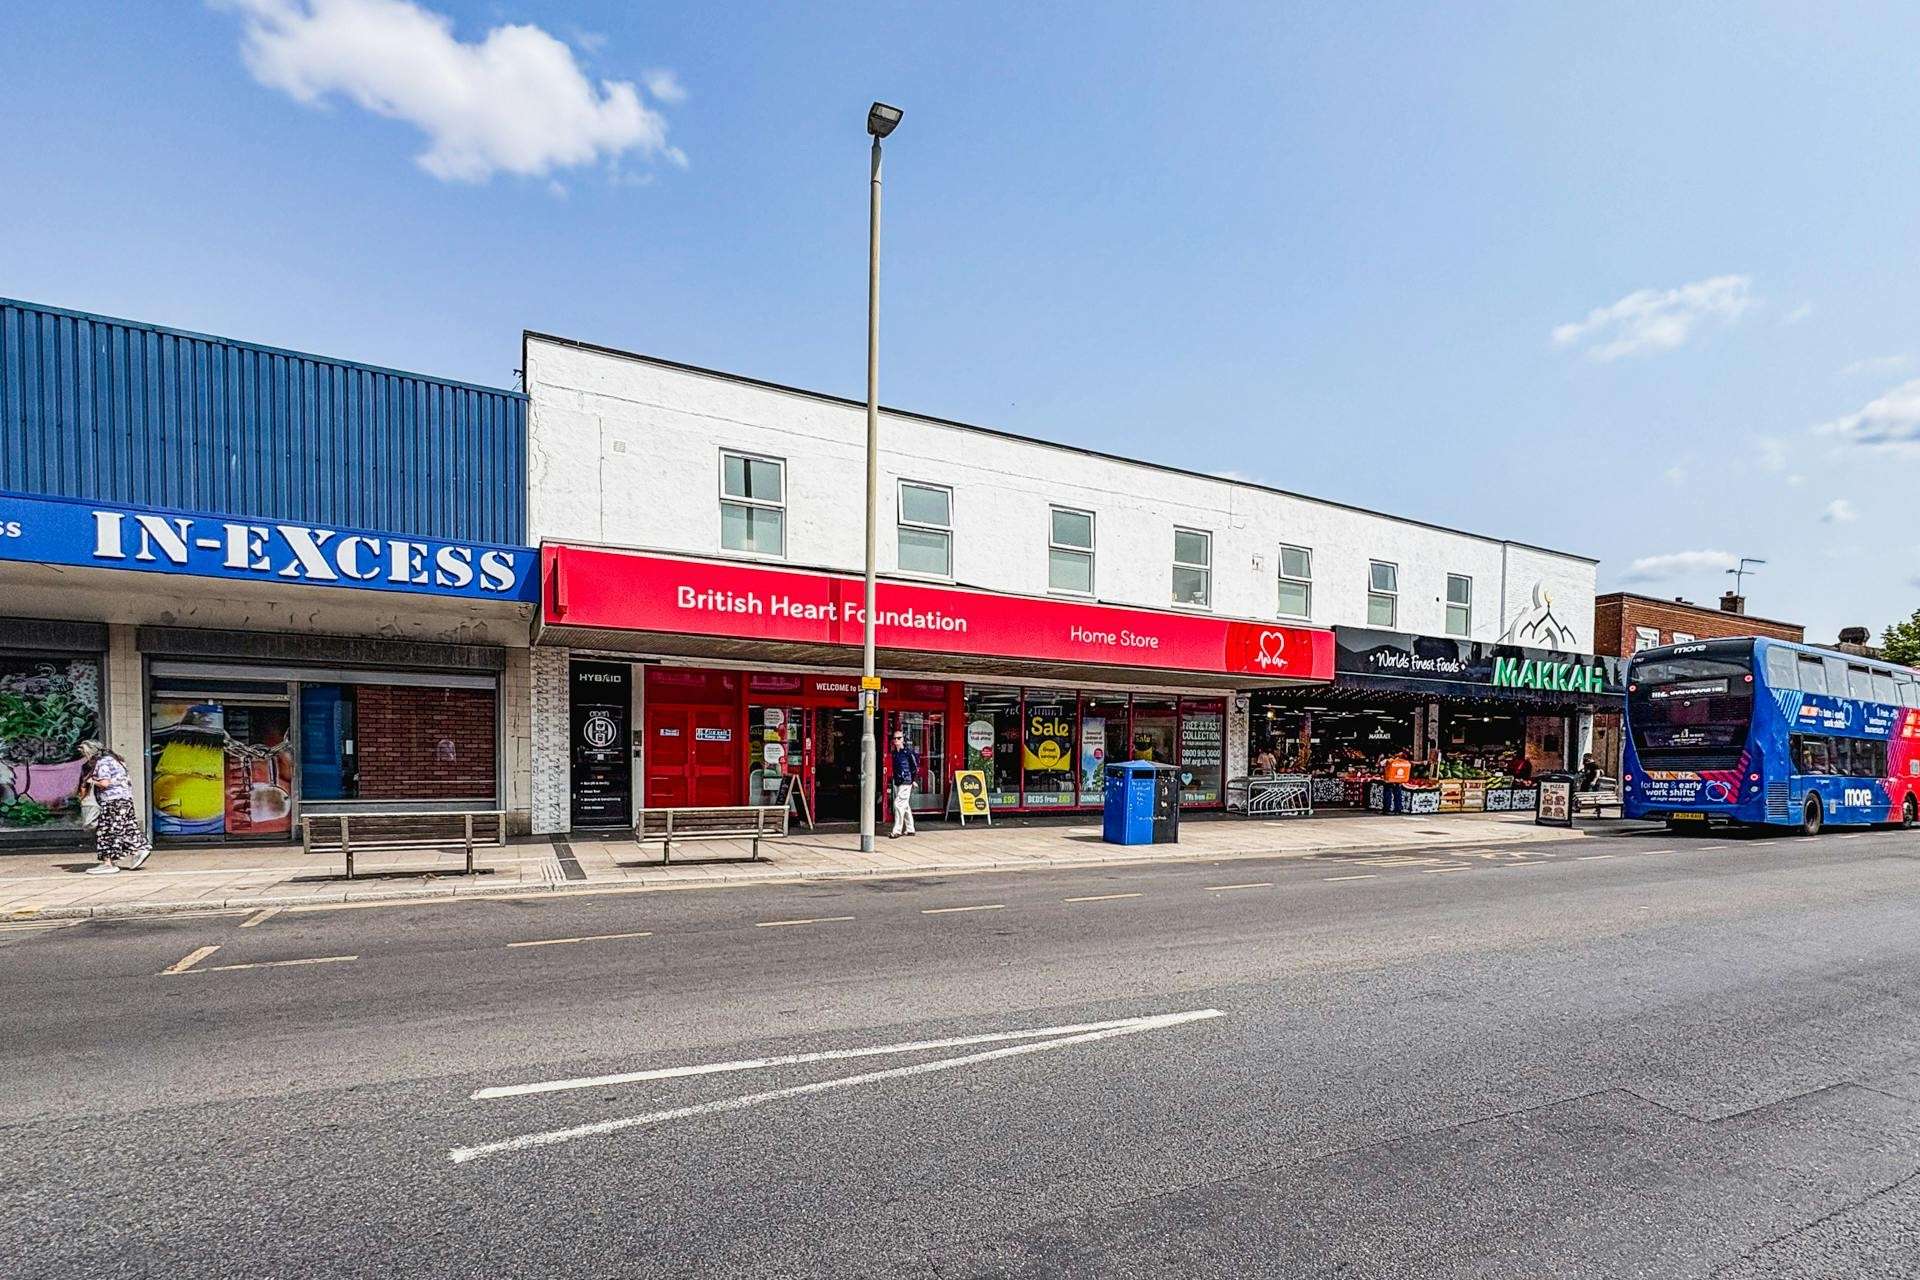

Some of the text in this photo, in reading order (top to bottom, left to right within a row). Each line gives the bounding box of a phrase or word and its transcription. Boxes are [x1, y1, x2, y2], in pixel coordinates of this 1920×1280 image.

[0, 521, 21, 537] s
[92, 510, 516, 591] IN-EXCESS
[677, 586, 967, 633] British Heart Foundation
[1070, 625, 1159, 648] Home Store
[1674, 645, 1706, 654] more
[1376, 650, 1460, 672] Worlds Finest Foods
[1492, 656, 1603, 693] MAKKAH
[816, 683, 849, 692] WELCOME
[1031, 716, 1069, 737] Sale
[1182, 721, 1198, 730] FREE
[1182, 731, 1220, 740] COLLECTION
[963, 781, 980, 790] Sale
[1679, 781, 1702, 790] early
[1844, 788, 1872, 807] more
